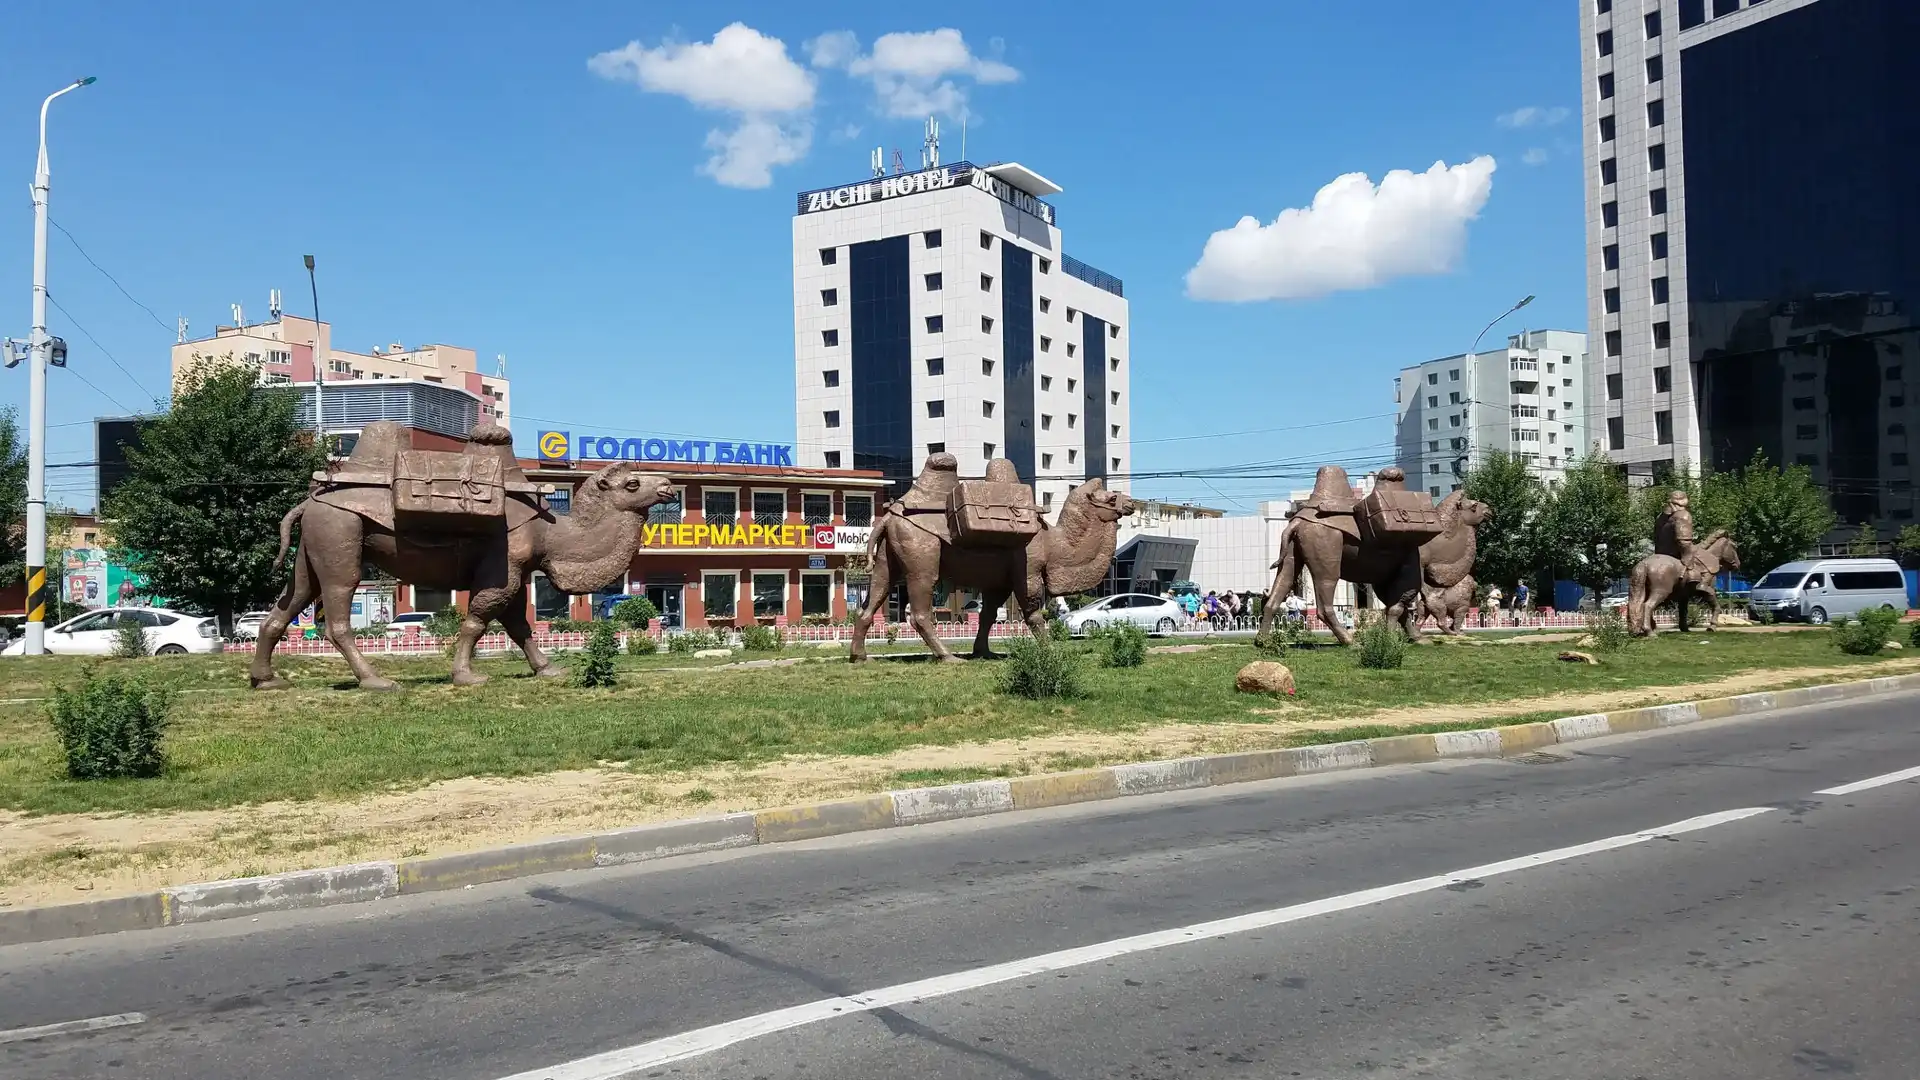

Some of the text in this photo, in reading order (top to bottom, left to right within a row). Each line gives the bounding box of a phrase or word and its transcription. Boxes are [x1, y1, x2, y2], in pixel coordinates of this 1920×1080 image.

[808, 168, 956, 212] ZUCHI HOTEL
[971, 167, 1010, 203] ZUCHI
[578, 436, 792, 466] ГОЛОМТ БАНК
[642, 523, 810, 546] УПЕРМАРКЕТ
[837, 531, 869, 544] MobiC
